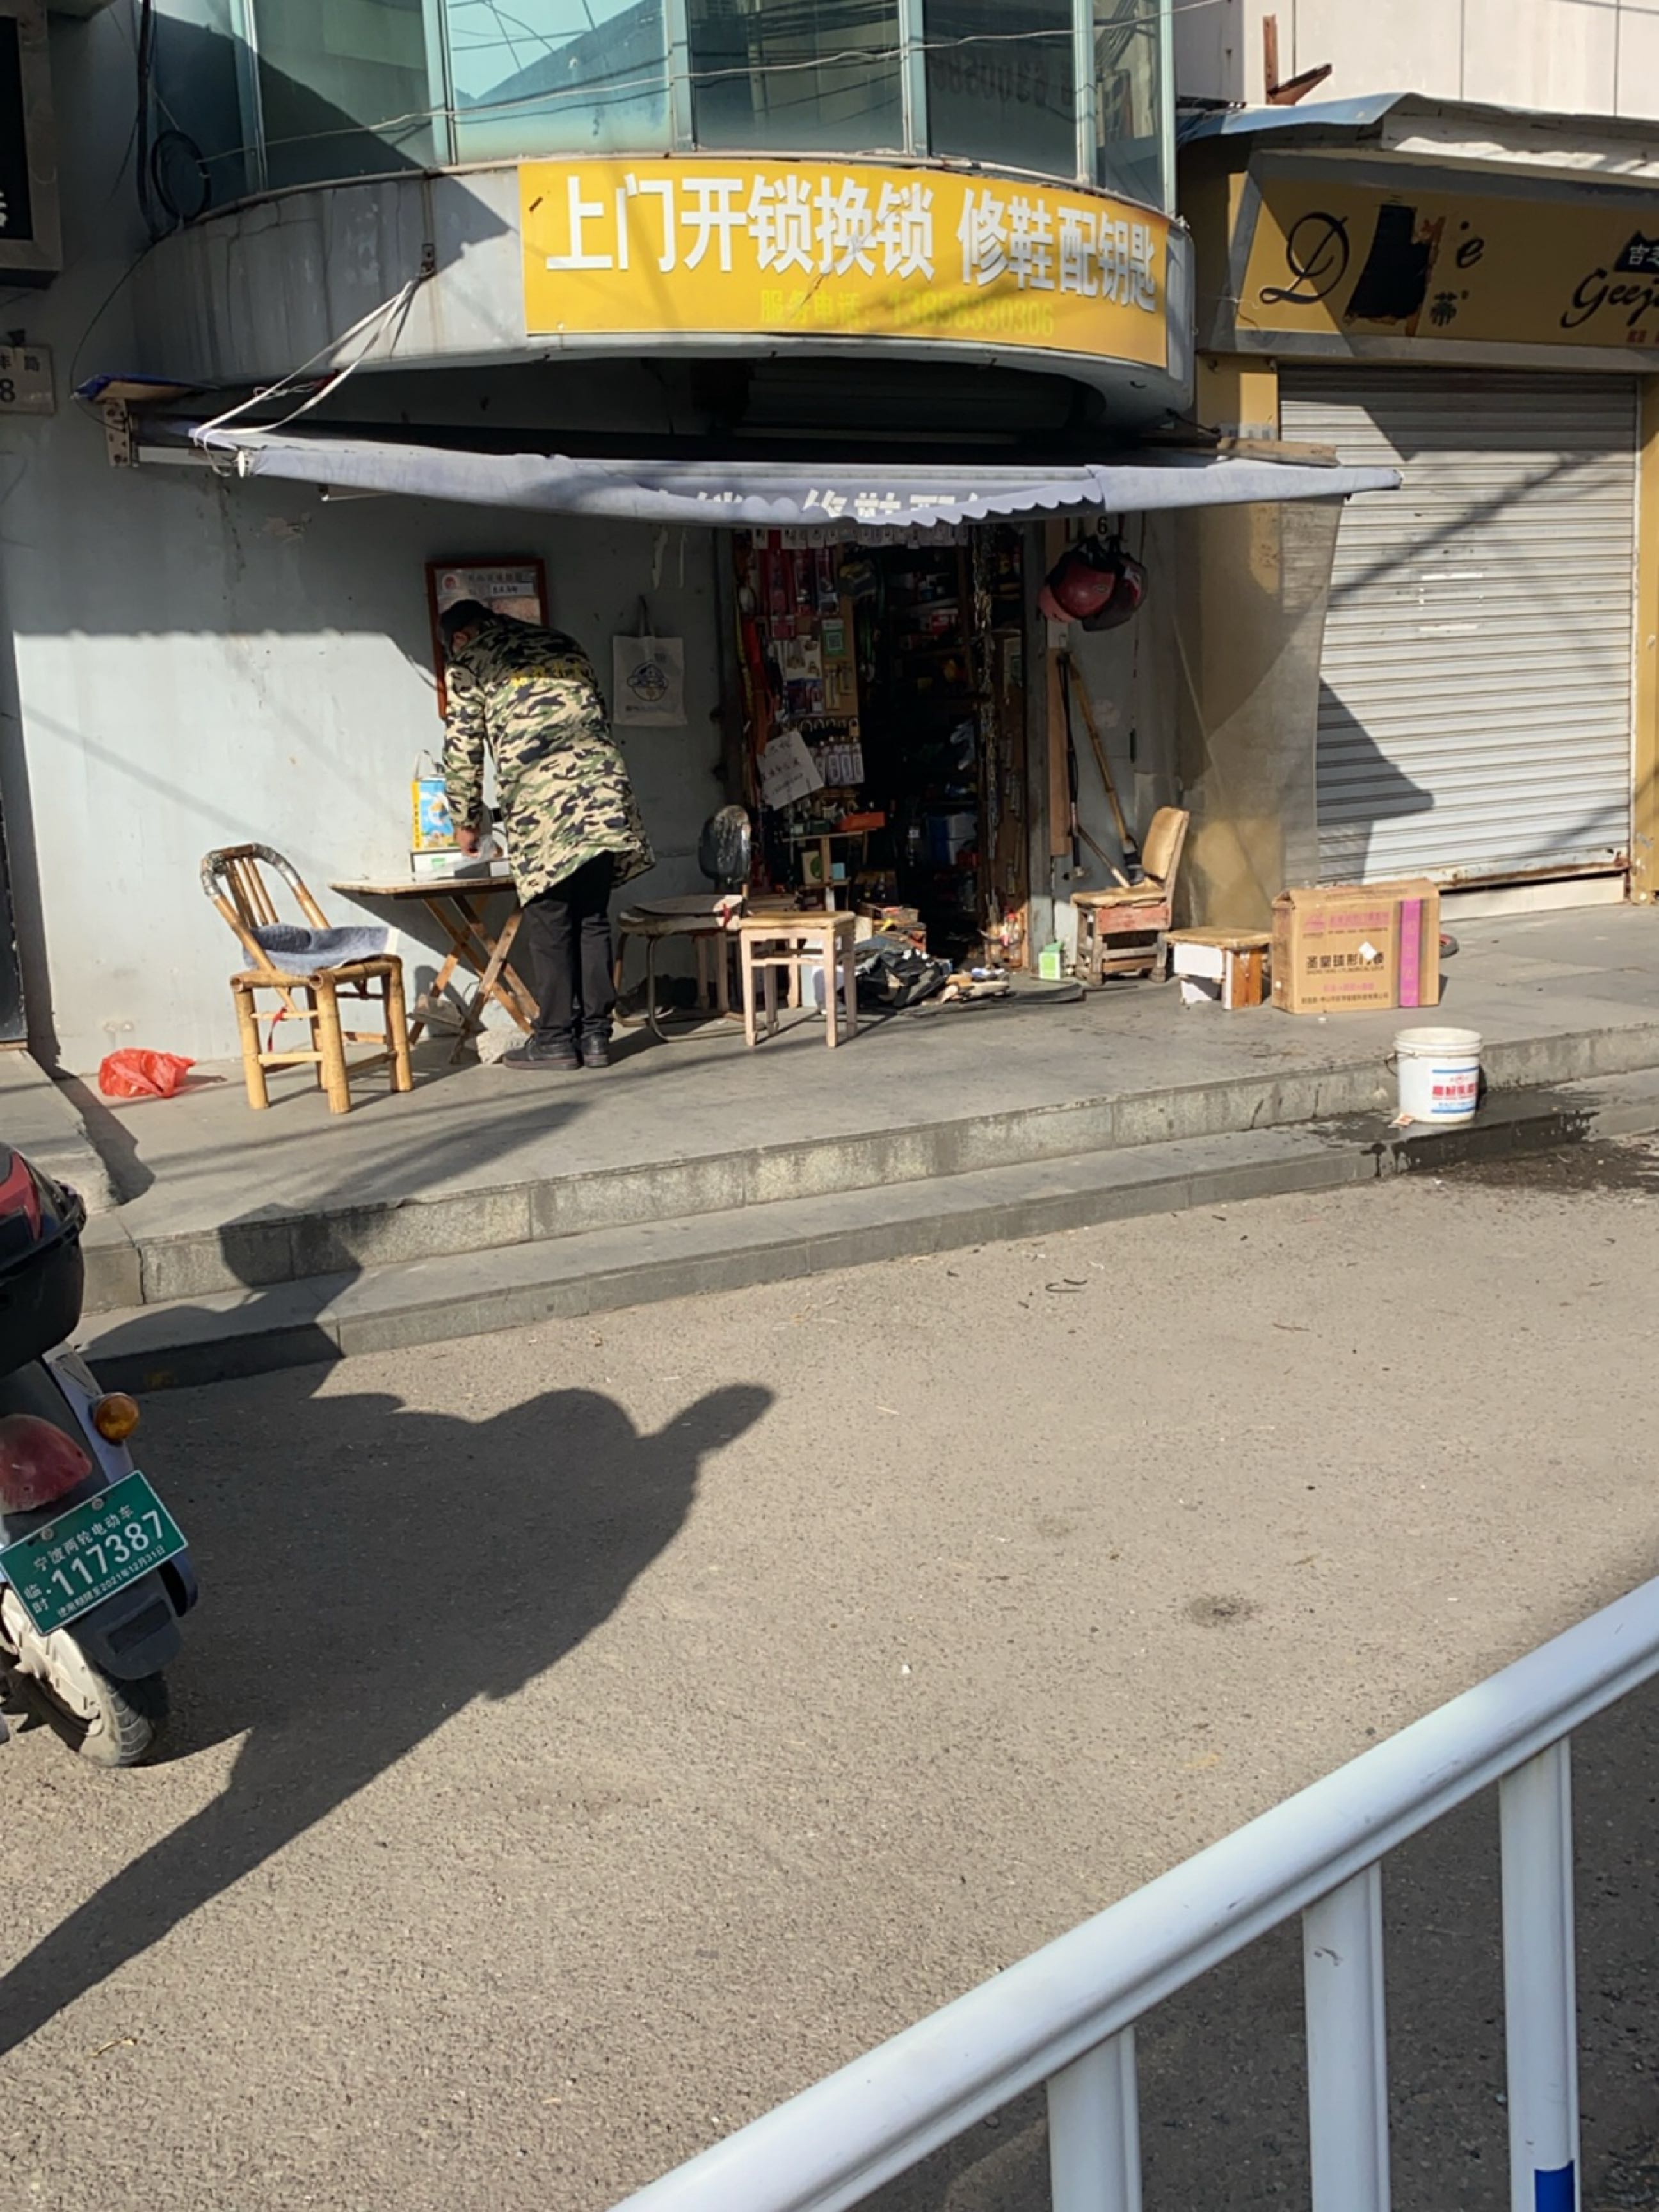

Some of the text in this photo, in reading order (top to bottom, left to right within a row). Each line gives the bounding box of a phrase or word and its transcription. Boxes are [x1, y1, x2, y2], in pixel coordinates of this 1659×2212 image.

[546, 173, 1157, 312] 上门开锁换锁 修鞋配钥匙
[51, 1509, 163, 1597] 117387
